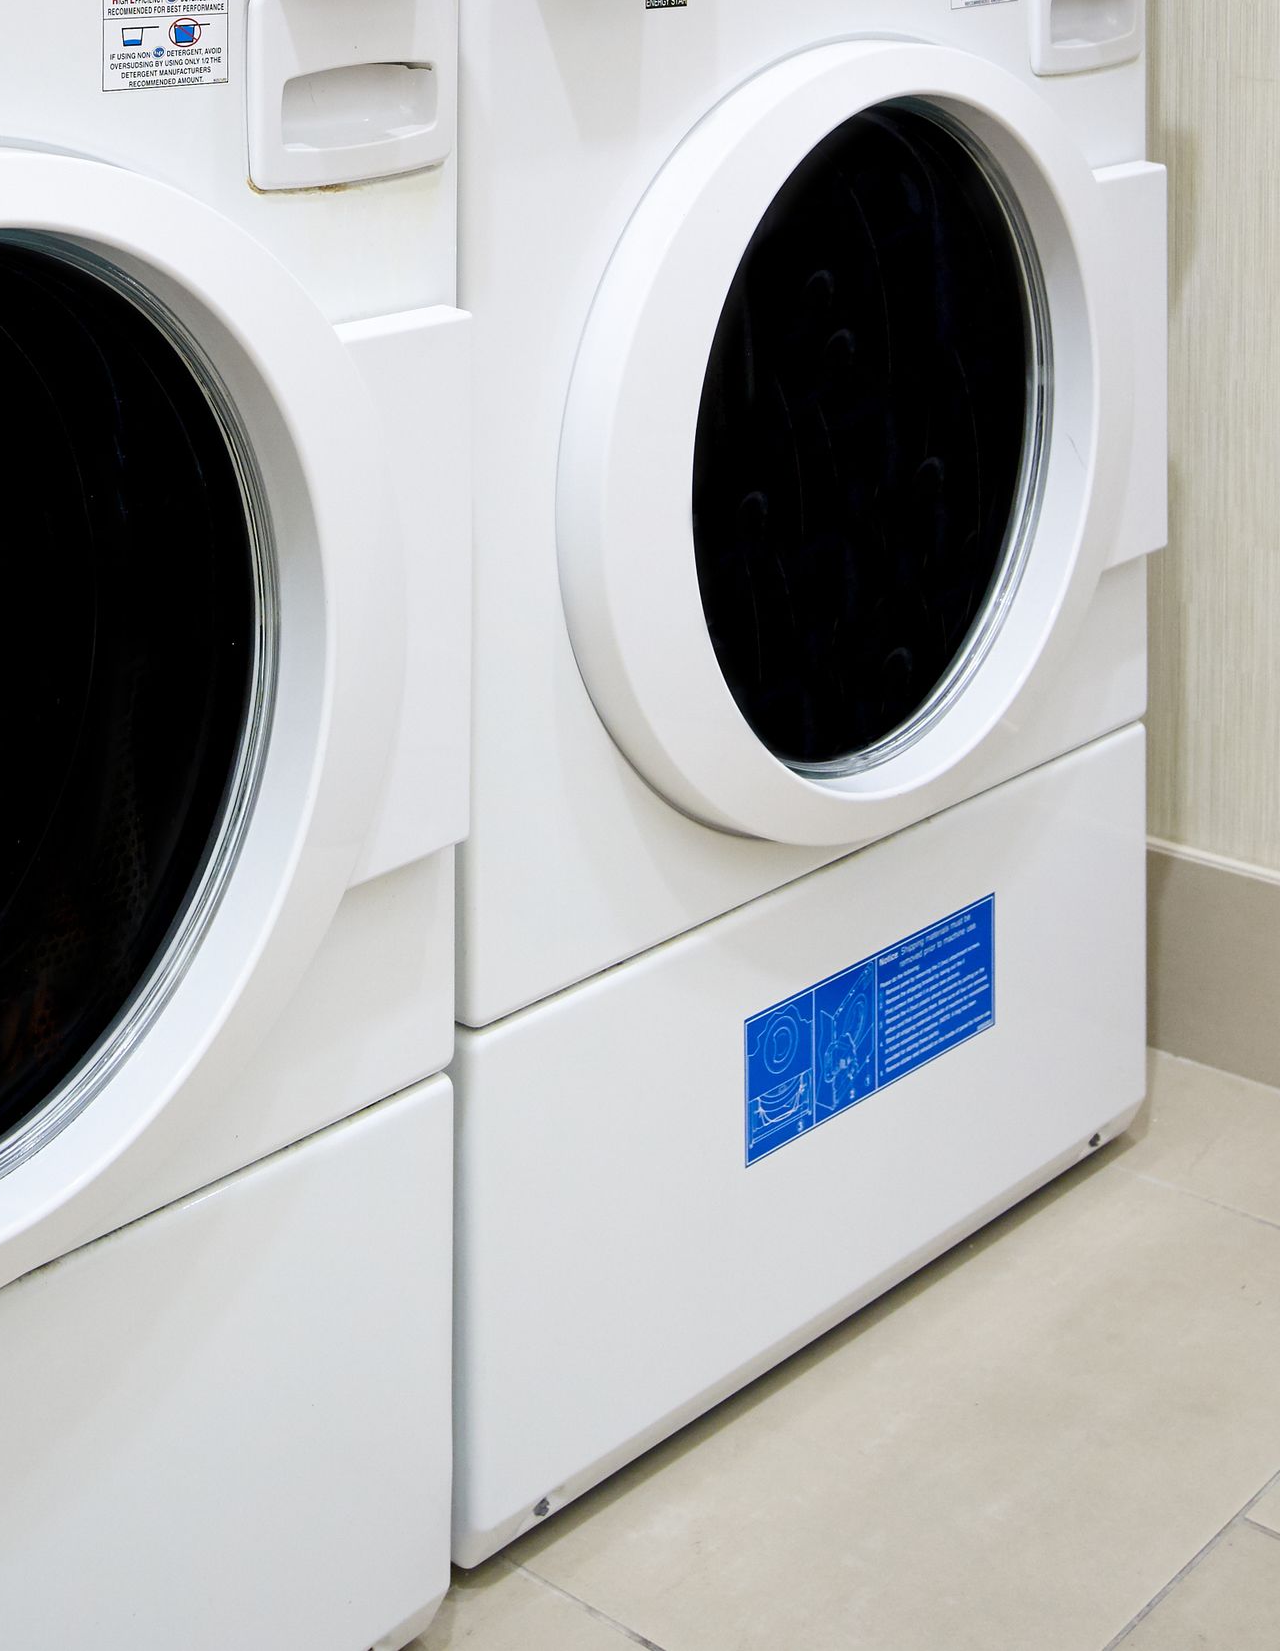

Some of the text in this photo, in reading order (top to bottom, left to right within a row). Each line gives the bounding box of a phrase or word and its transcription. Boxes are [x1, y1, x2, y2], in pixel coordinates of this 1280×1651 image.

[108, 7, 152, 15] RECOMMENDED
[167, 5, 181, 13] BEST
[183, 3, 224, 12] PERFORMANCE
[167, 49, 203, 57] DETERGENT,
[121, 66, 211, 78] DETERGENT MANUFACTURERS
